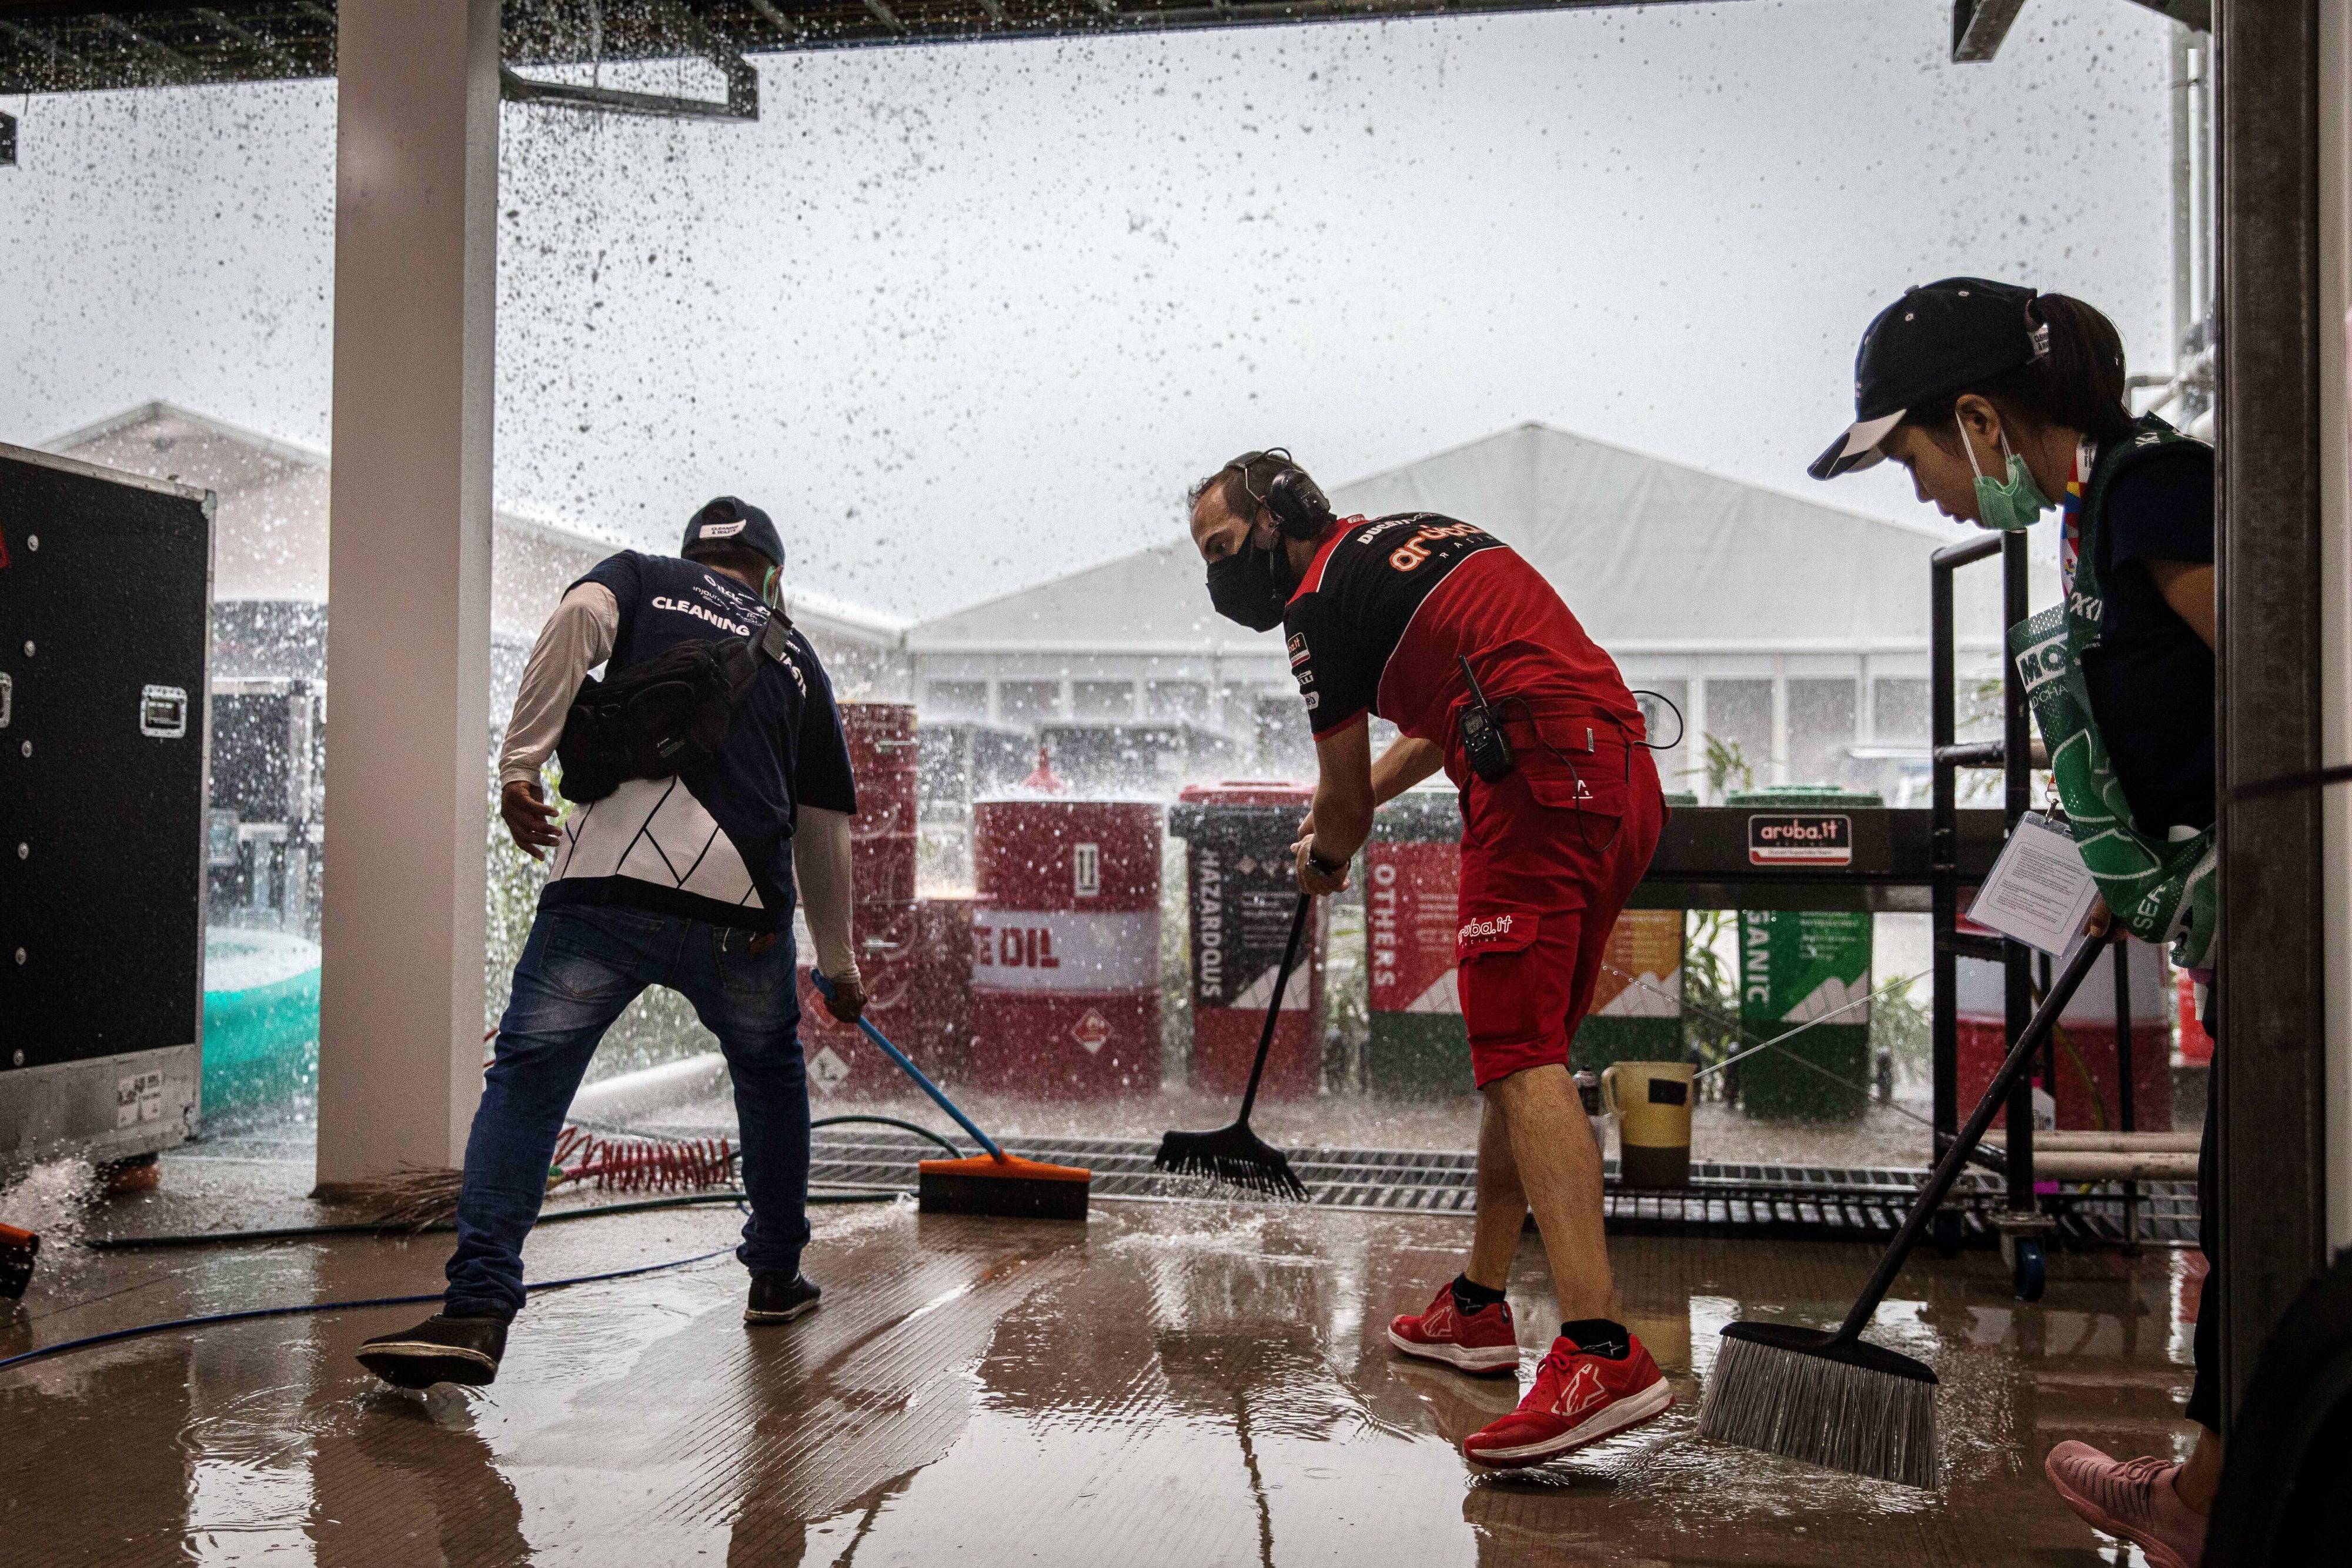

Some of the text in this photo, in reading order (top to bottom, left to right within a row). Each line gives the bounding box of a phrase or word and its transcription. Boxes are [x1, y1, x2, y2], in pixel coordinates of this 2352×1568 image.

[1357, 519, 1411, 545] DUCATI
[652, 596, 750, 636] CLEANING
[1760, 818, 1838, 840] aruba.it
[1200, 848, 1222, 997] HAZARDOUS
[1374, 864, 1396, 986] OTHERS
[1000, 927, 1060, 968] OIL
